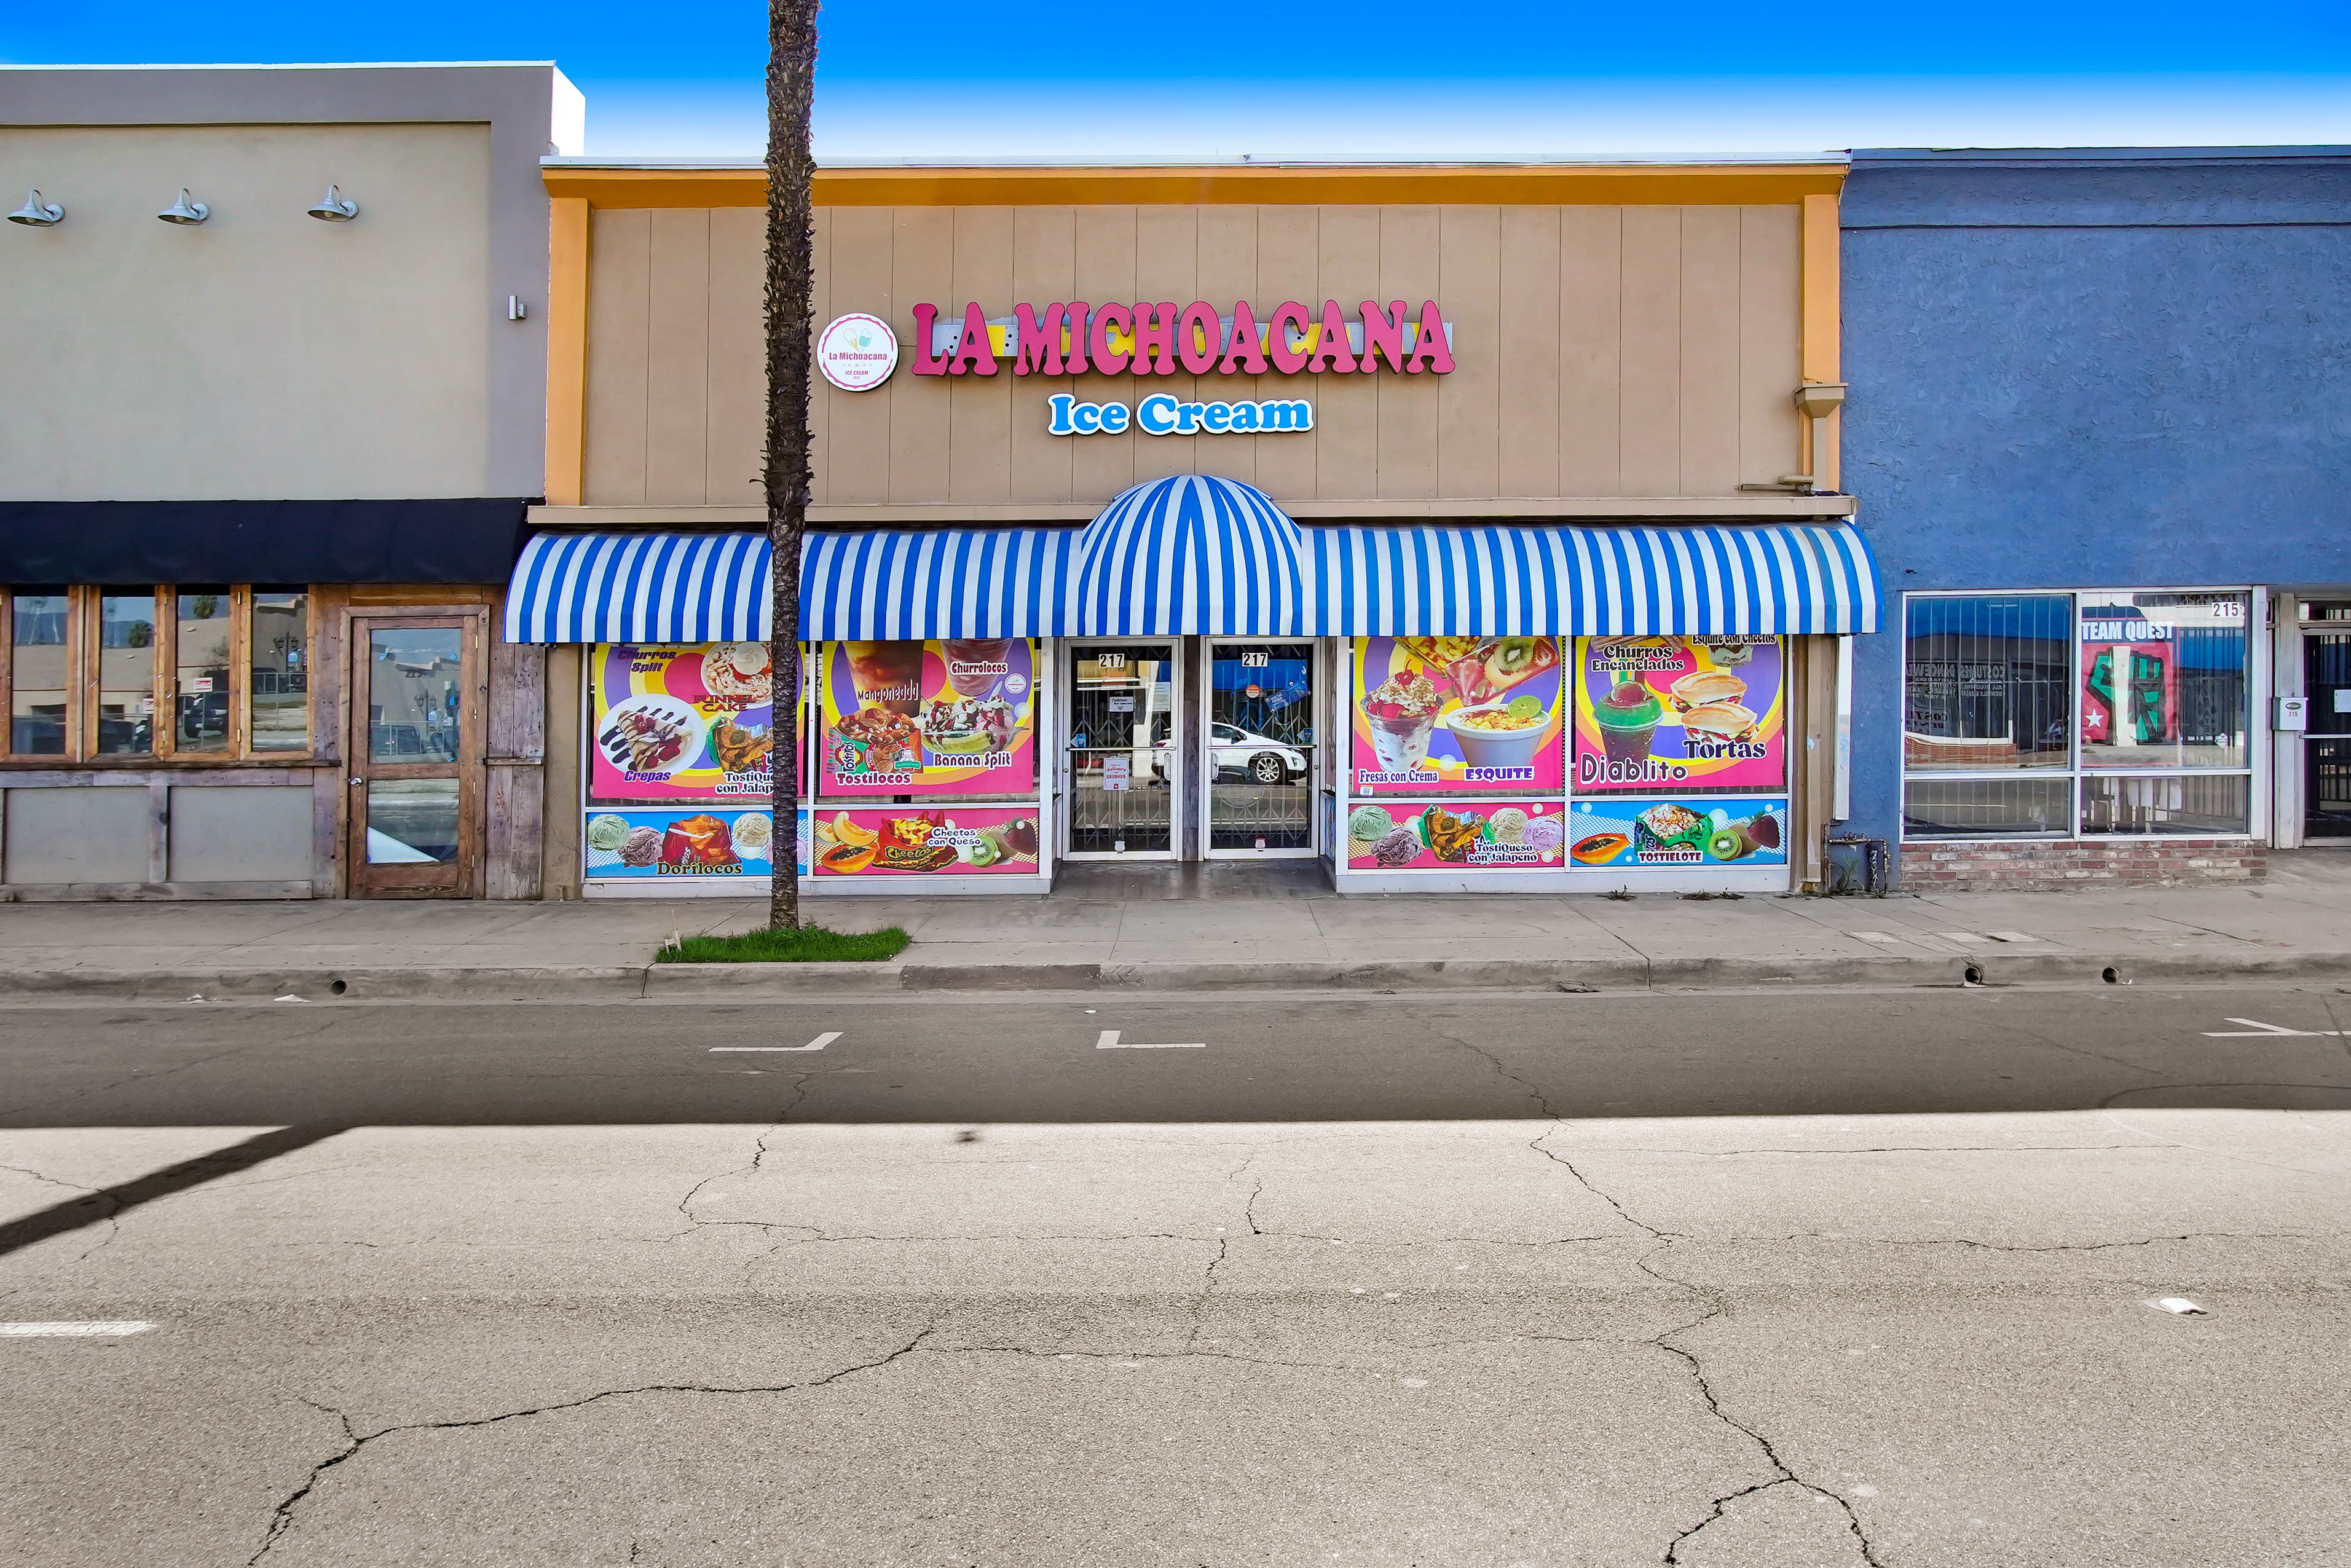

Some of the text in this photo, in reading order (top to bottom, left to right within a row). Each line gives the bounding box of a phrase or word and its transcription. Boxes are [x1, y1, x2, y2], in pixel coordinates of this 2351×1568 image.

[912, 300, 1456, 376] LA MICHOACANA
[1052, 395, 1311, 431] Ice Cream
[2213, 603, 2238, 617] 215
[2082, 621, 2175, 641] TEAM QUEST
[617, 650, 677, 660] Churros
[1604, 645, 1674, 658] Churros
[1100, 655, 1124, 667] 217
[1243, 653, 1267, 666] 217
[1592, 658, 1684, 671] Encanelados
[631, 663, 663, 672] Split
[952, 662, 1006, 674] Churrolocos
[694, 695, 757, 703] FUNNEL
[1684, 740, 1766, 758] Tortas
[935, 754, 980, 766] Banana
[985, 752, 1010, 768] Split
[1581, 754, 1687, 781] Diablito
[624, 771, 671, 782] Crepas
[725, 772, 773, 783] TostiQu
[837, 773, 910, 784] Tostilocos
[1360, 770, 1438, 782] Fresas con Crema
[1465, 768, 1532, 781] ESQUITE
[742, 784, 773, 794] Jalap
[933, 828, 976, 837] Cheetos
[1476, 843, 1533, 853] TostiQueso
[1639, 852, 1701, 861] TOSTIELOTE
[657, 862, 742, 875] Dorilocos
